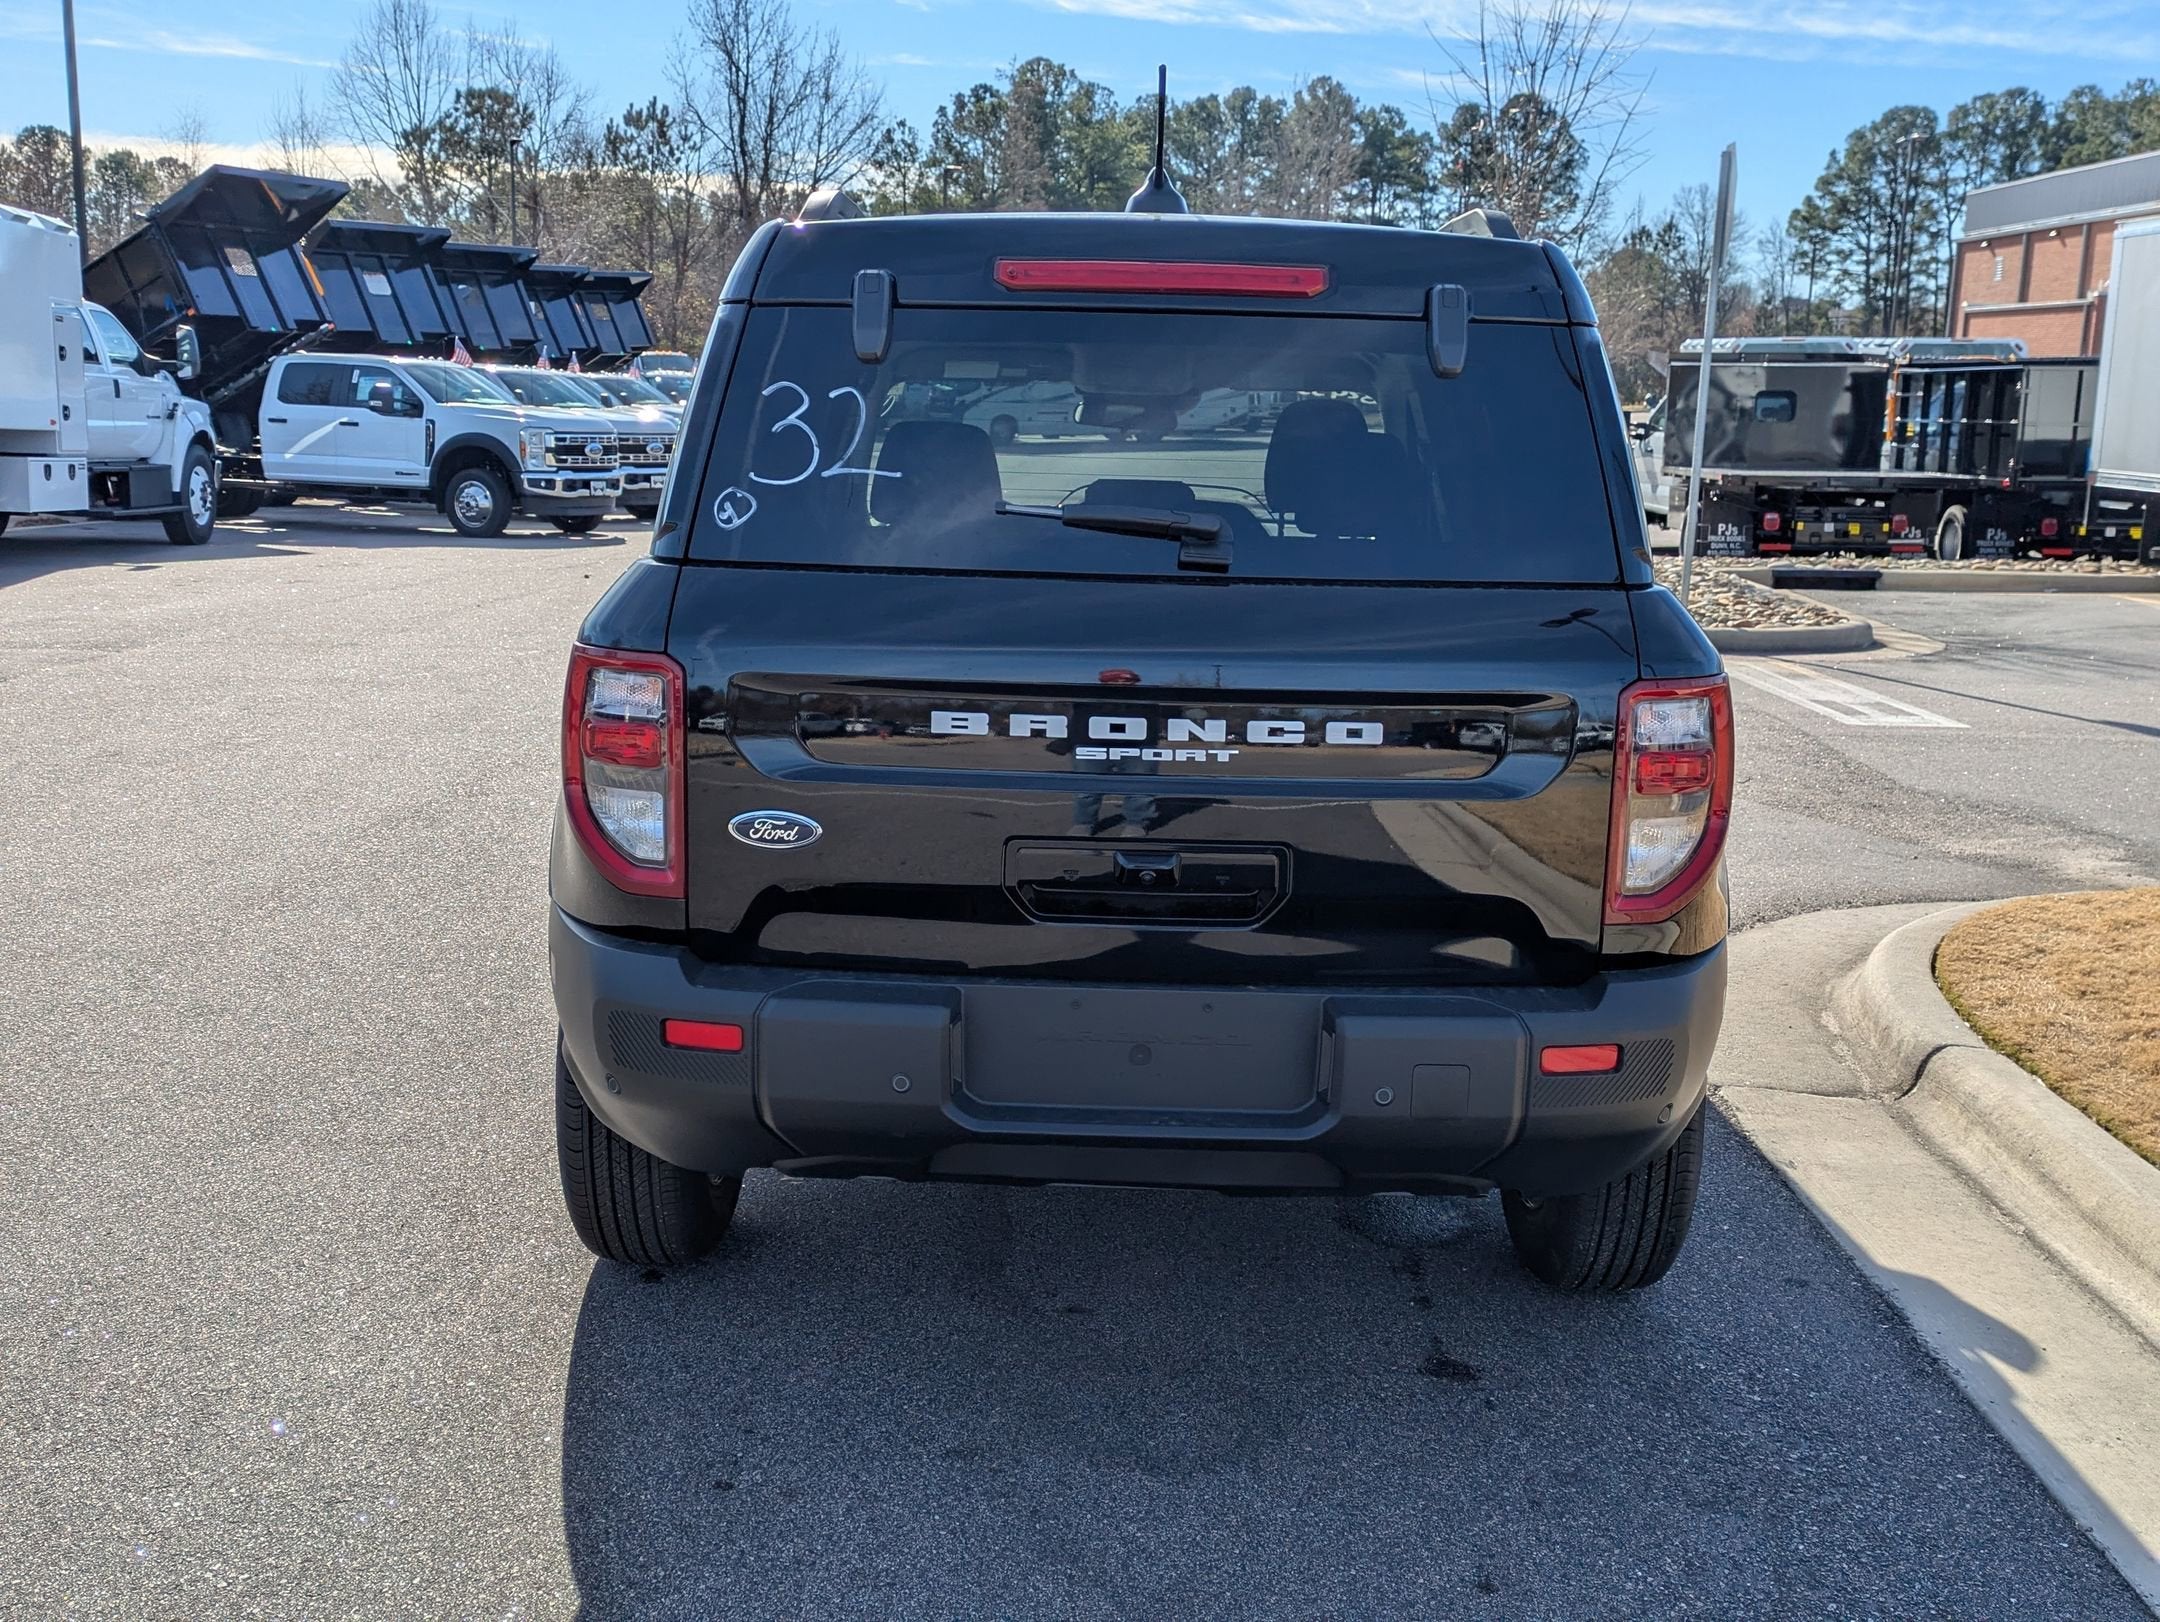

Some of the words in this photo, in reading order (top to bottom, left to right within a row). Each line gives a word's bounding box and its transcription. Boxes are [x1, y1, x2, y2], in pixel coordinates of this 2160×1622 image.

[749, 381, 902, 485] 32
[930, 709, 1384, 746] BRONCO
[1075, 746, 1240, 763] SPORT
[748, 818, 799, 841] Ford
